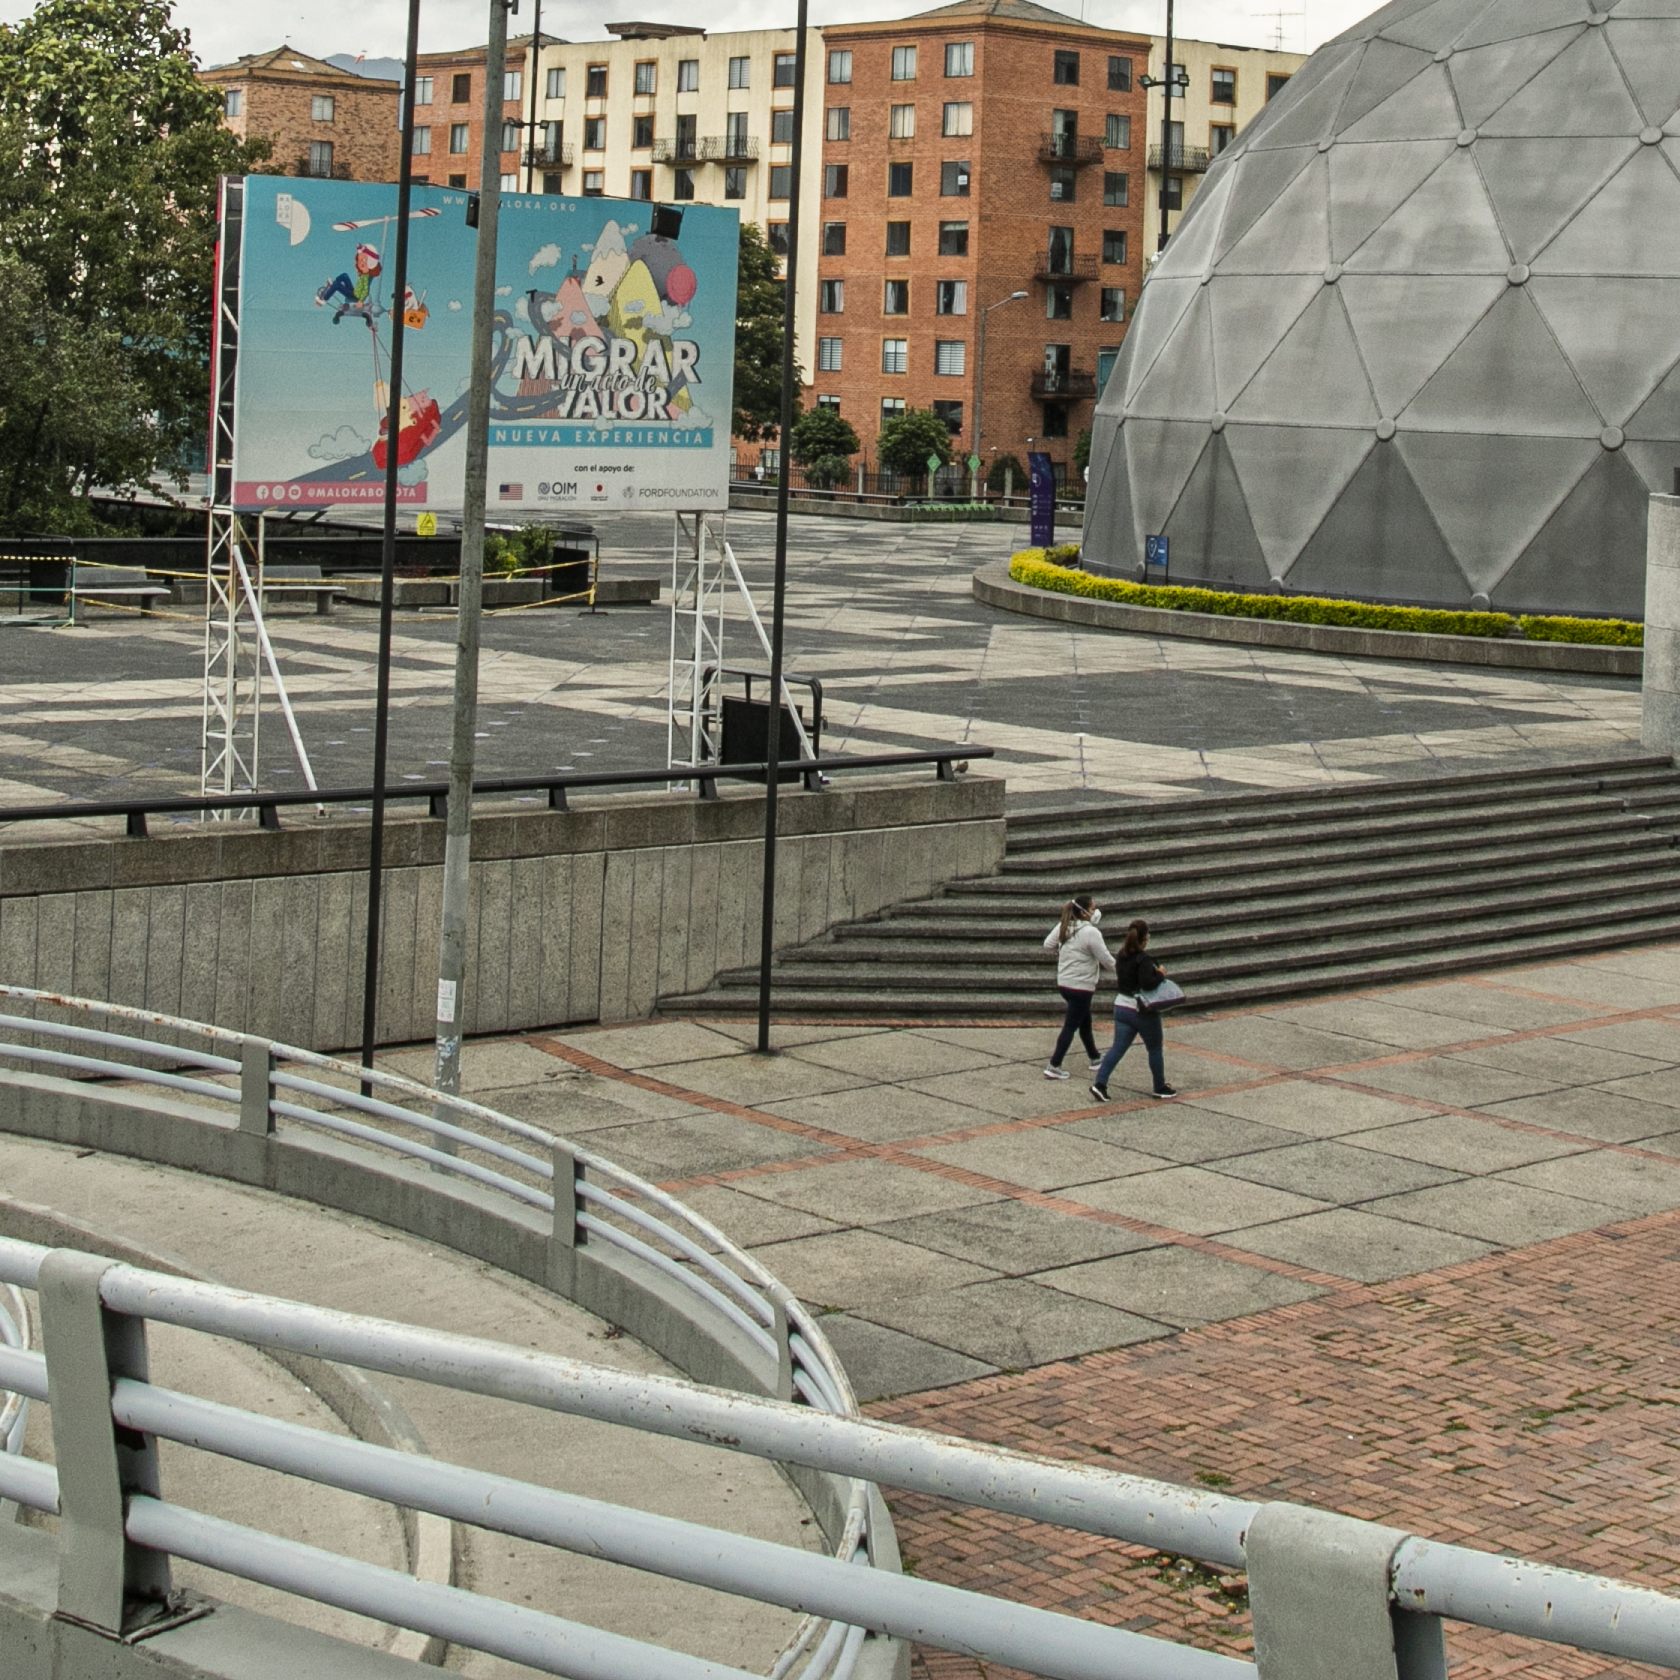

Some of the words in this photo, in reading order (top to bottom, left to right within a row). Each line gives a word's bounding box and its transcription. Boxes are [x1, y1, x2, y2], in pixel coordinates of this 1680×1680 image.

[512, 335, 702, 384] MIGRAR
[561, 373, 584, 392] un
[589, 369, 628, 392] acto
[633, 366, 657, 394] de
[551, 386, 672, 420] VALOR
[495, 429, 562, 443] NUEVA
[574, 430, 704, 445] EXPERIENCIA
[590, 464, 597, 472] el
[599, 465, 621, 474] apoyo
[623, 464, 635, 472] de:
[307, 487, 417, 498] @MALOKABOOTA
[552, 482, 577, 495] OIM
